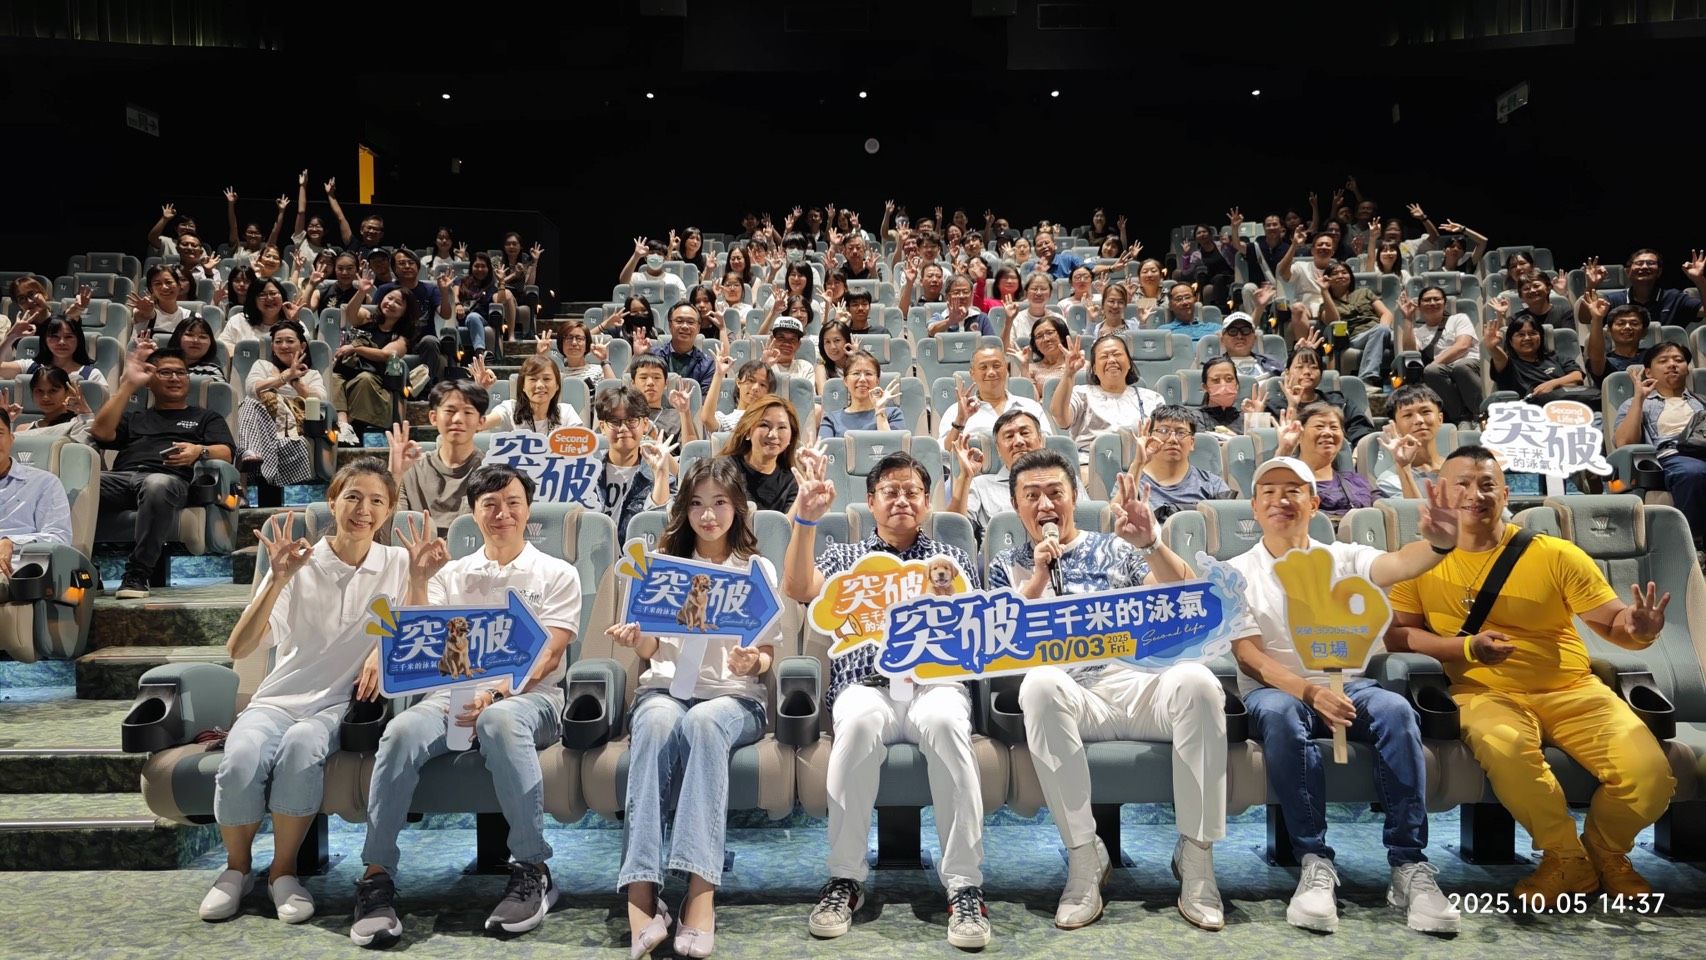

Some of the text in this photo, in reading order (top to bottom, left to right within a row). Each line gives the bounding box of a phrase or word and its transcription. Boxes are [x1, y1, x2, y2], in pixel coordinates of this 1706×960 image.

[720, 390, 729, 399] 10
[832, 390, 839, 400] 9
[555, 433, 589, 443] Second
[1487, 406, 1607, 474] 突破
[560, 444, 578, 453] Life
[1106, 449, 1112, 460] 7
[1506, 447, 1544, 459] 三千米
[828, 454, 836, 464] 9
[1237, 452, 1245, 462] 6
[464, 535, 476, 548] 11
[1186, 533, 1193, 547] 7
[1366, 531, 1374, 543] 6
[638, 570, 751, 625] 突破
[884, 589, 1208, 669] 突破 三千米的泳氣
[392, 614, 517, 670] 突破
[1107, 634, 1129, 644] 2025
[1038, 637, 1105, 662] 10/03
[1110, 642, 1130, 655] Fri.
[1311, 640, 1348, 659] 包場
